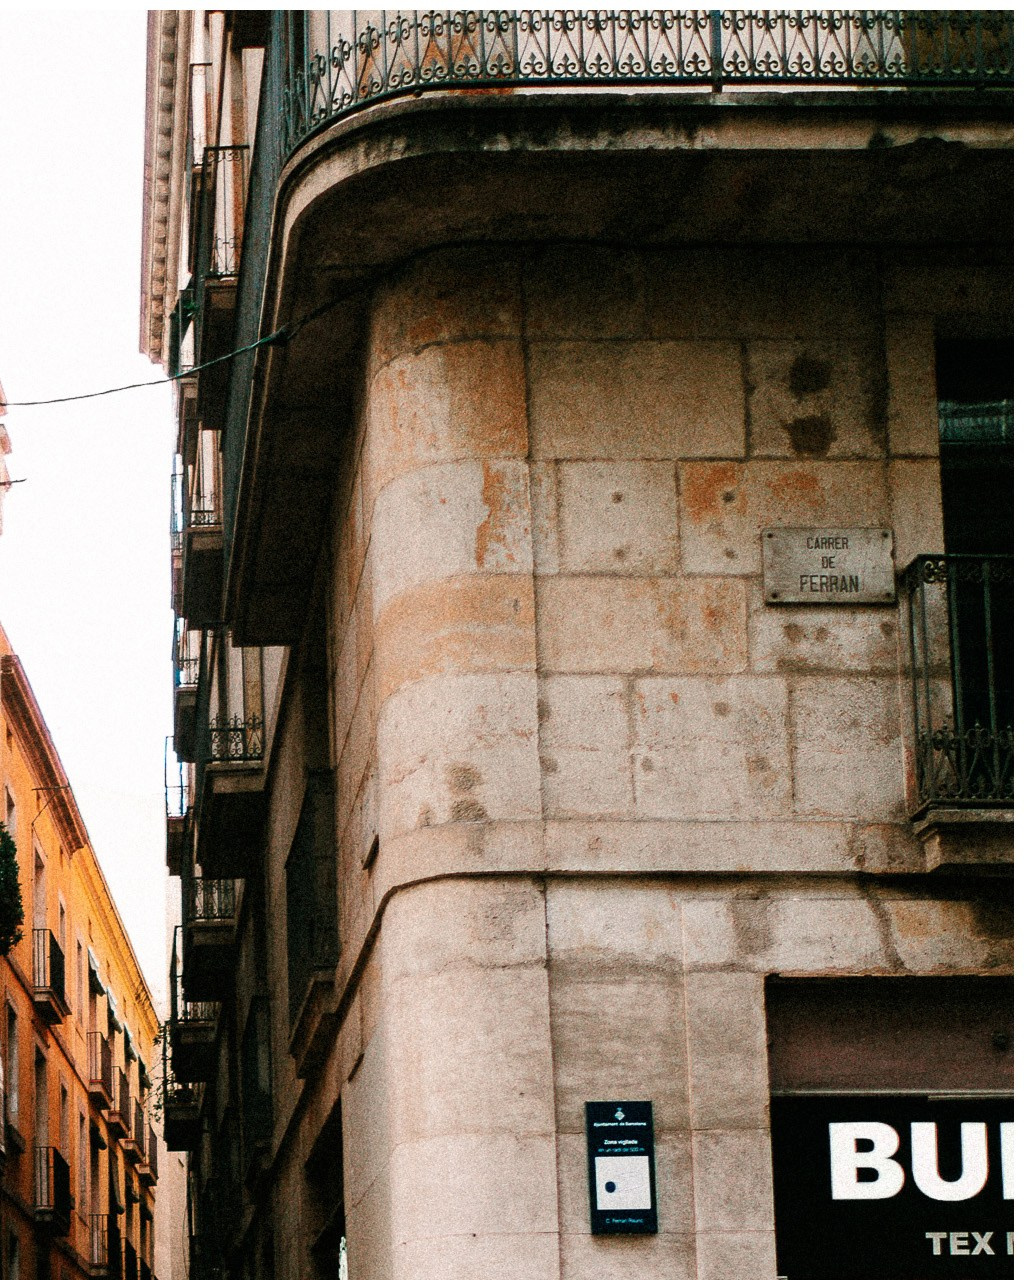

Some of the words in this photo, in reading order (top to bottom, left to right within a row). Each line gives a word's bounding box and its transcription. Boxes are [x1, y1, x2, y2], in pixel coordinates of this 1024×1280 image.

[806, 536, 849, 550] CARRER
[821, 555, 836, 569] DE
[799, 574, 860, 593] FERRAN
[925, 1231, 996, 1256] TEX
